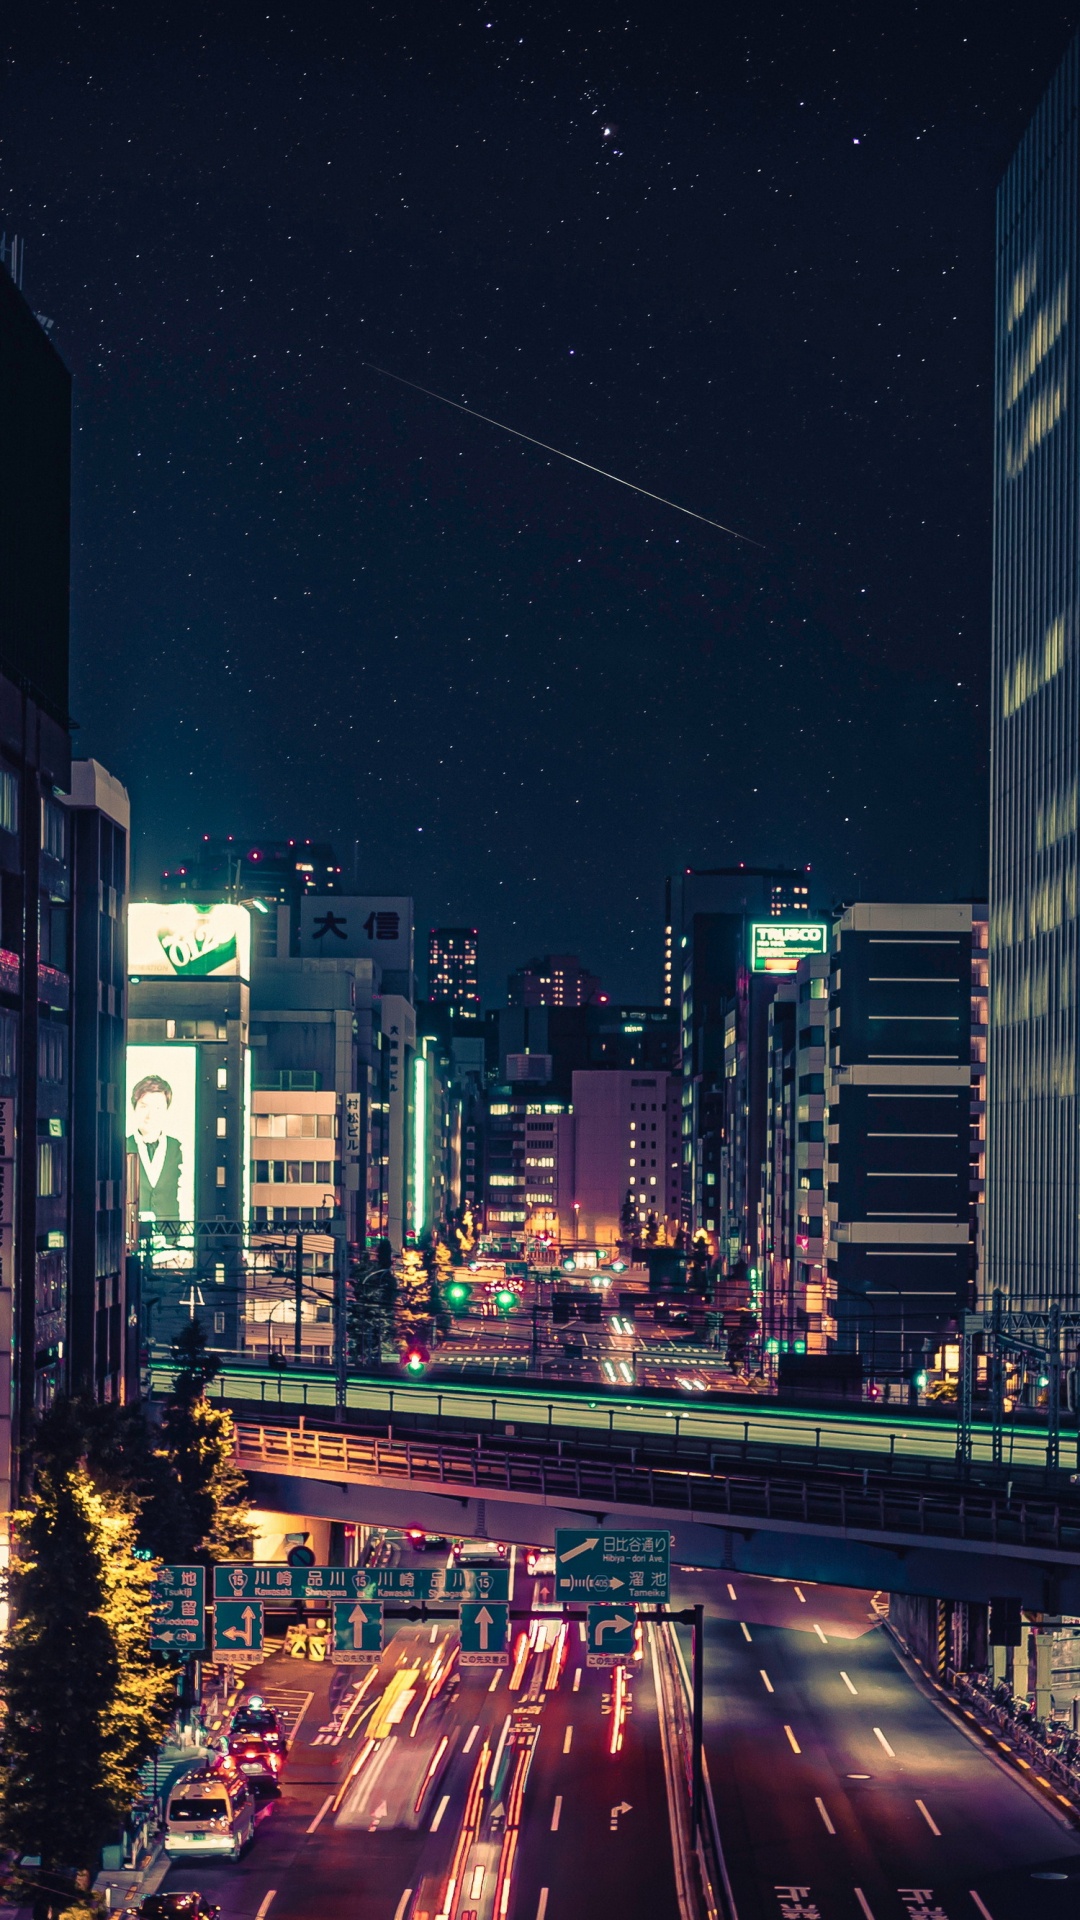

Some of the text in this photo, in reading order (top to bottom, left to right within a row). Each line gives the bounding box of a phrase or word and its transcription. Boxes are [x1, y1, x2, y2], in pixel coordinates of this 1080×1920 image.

[312, 911, 400, 940] 大信
[757, 928, 821, 941] TRUSCO
[347, 1098, 359, 1151] 村松ビル
[603, 1536, 666, 1552] 日比谷通り
[648, 1554, 665, 1563] Ave.
[232, 1575, 244, 1586] 15
[255, 1570, 292, 1587] 川崎
[307, 1570, 345, 1587] 品川
[355, 1576, 367, 1587] 15
[377, 1571, 415, 1588] 川崎
[478, 1578, 490, 1588] 15
[628, 1571, 667, 1587] 溜池
[163, 1587, 193, 1598] Tsukiji
[254, 1587, 292, 1597] Kawasaki
[304, 1587, 347, 1598] Shinagawa
[377, 1588, 415, 1597] Kawasaki
[628, 1588, 666, 1597] Tameike
